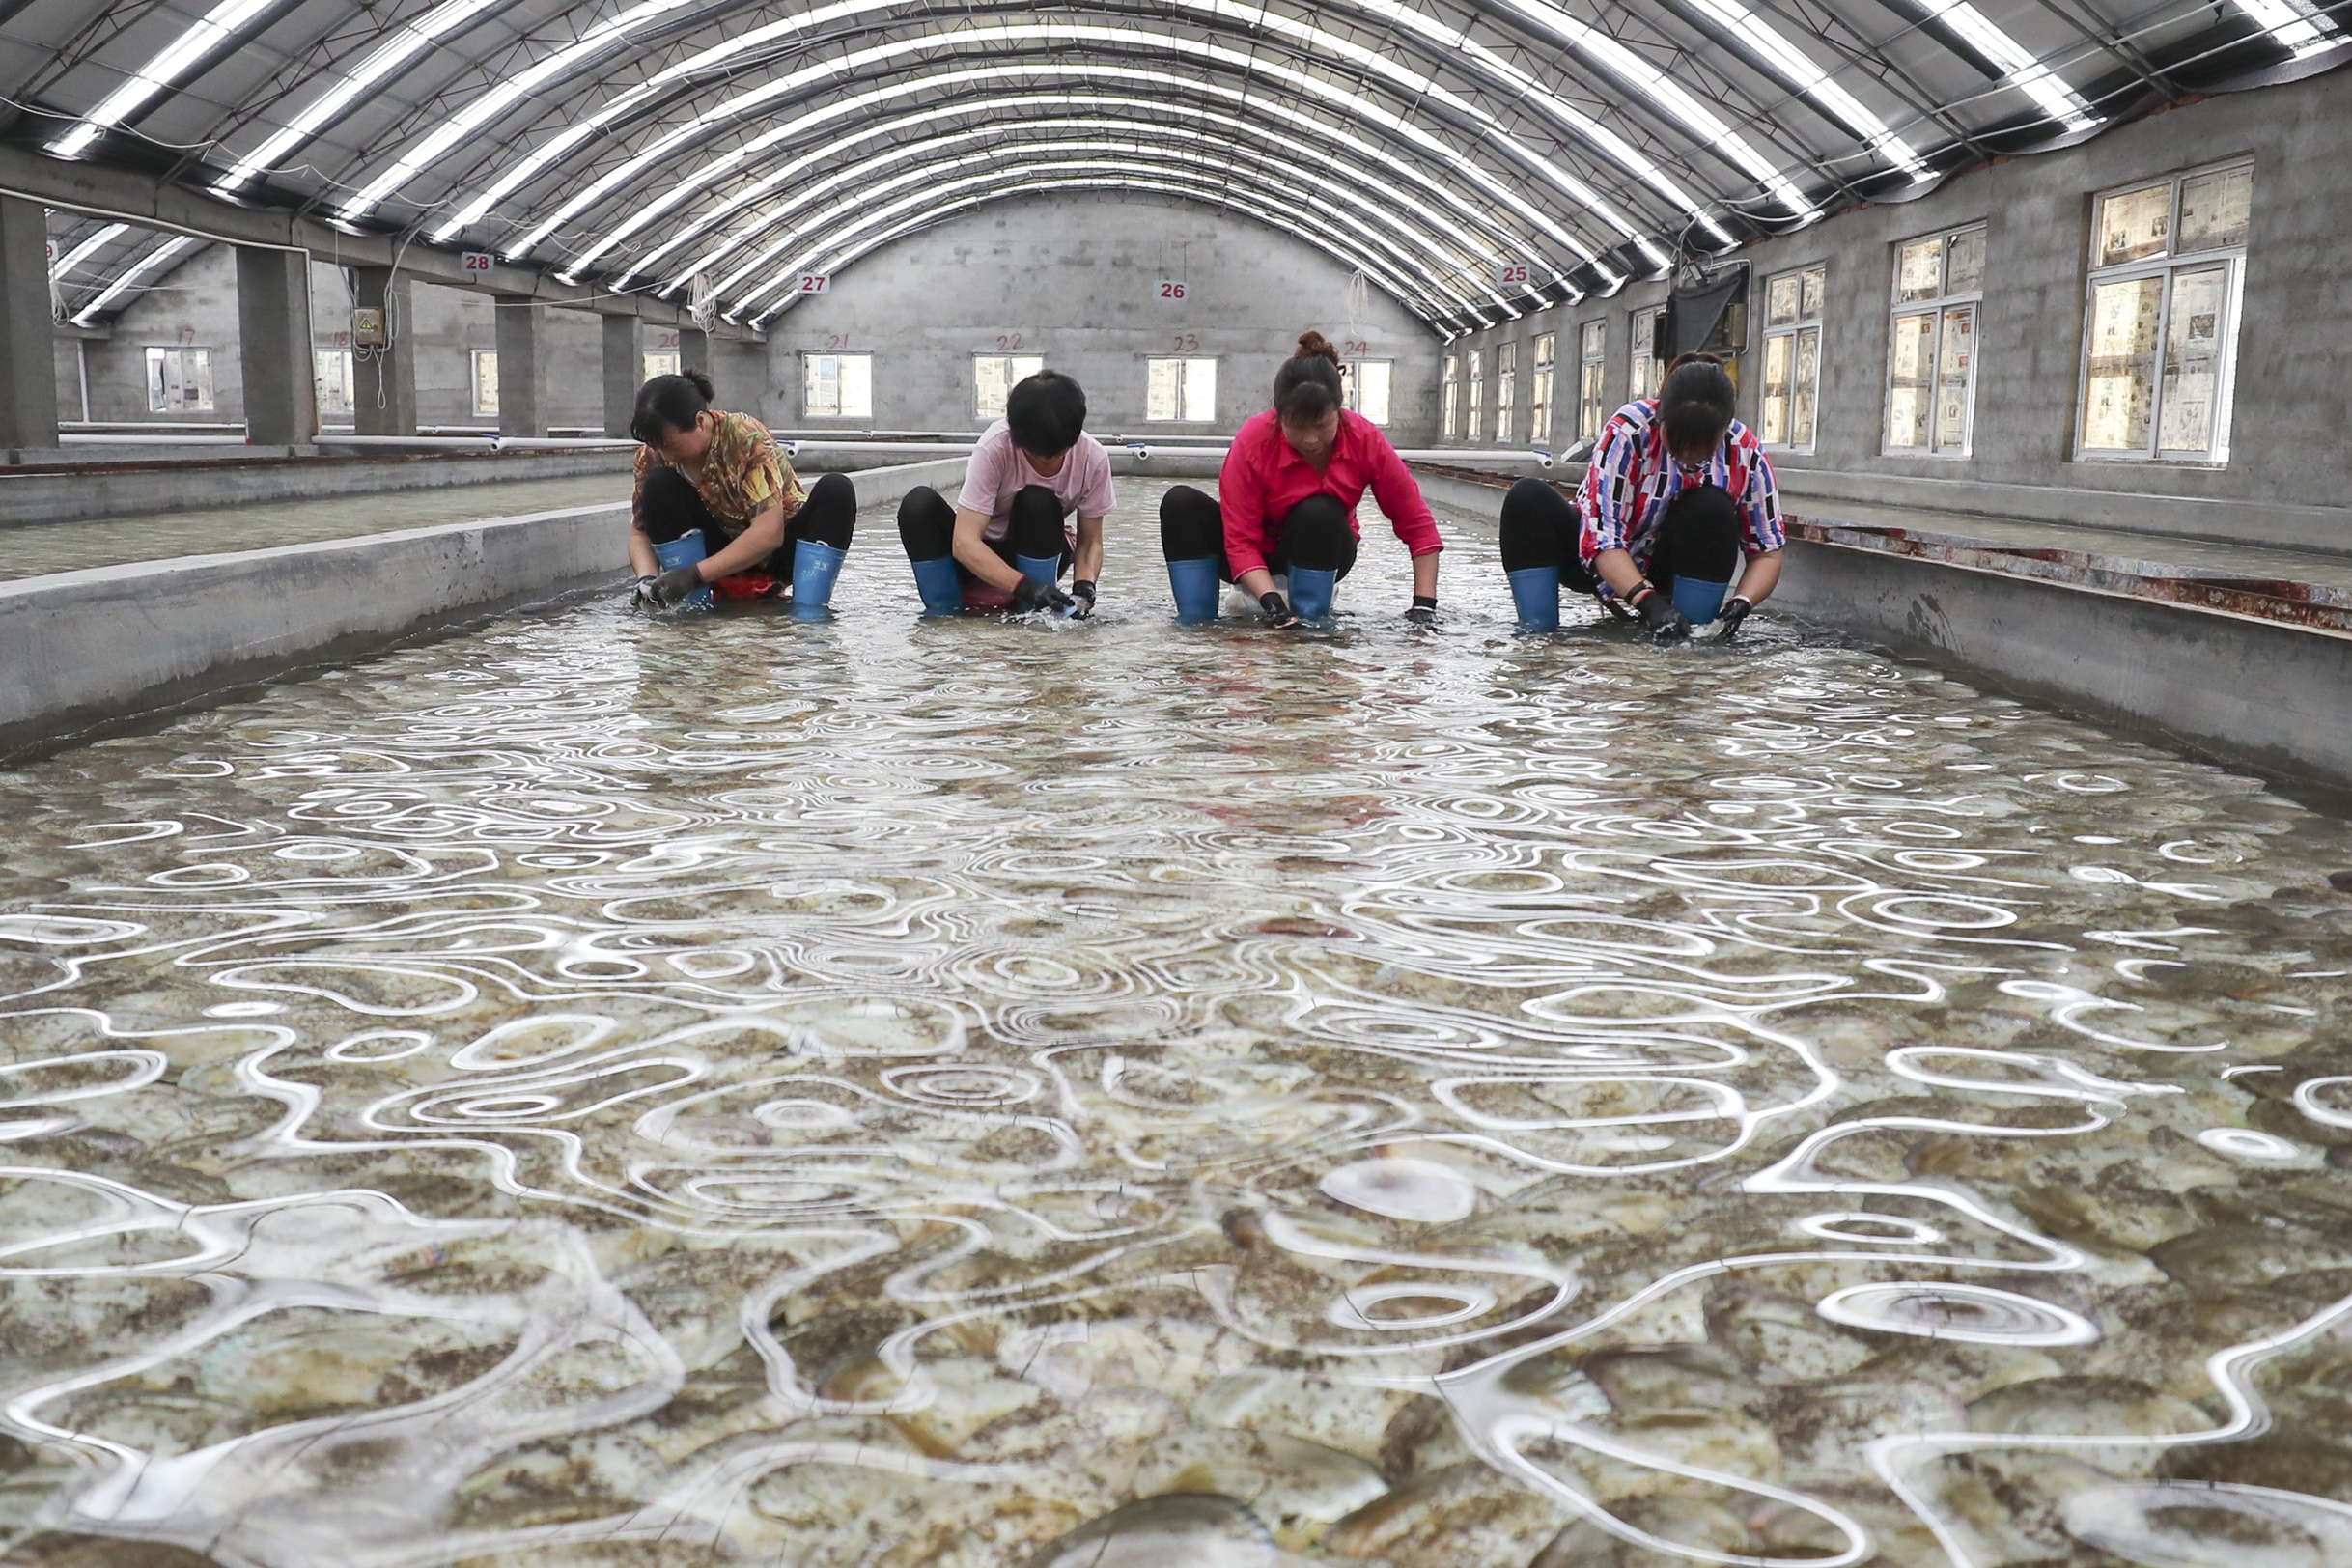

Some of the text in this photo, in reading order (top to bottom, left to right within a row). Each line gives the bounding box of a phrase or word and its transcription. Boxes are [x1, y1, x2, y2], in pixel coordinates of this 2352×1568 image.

[46, 244, 53, 258] 9
[467, 256, 489, 269] 28
[1503, 266, 1527, 283] 25
[802, 276, 826, 291] 27
[1161, 283, 1185, 298] 26
[178, 328, 196, 346] 17
[333, 331, 349, 348] 18
[829, 333, 849, 349] 21
[996, 333, 1024, 351] 22
[1174, 333, 1199, 351] 23
[1343, 340, 1370, 356] 24
